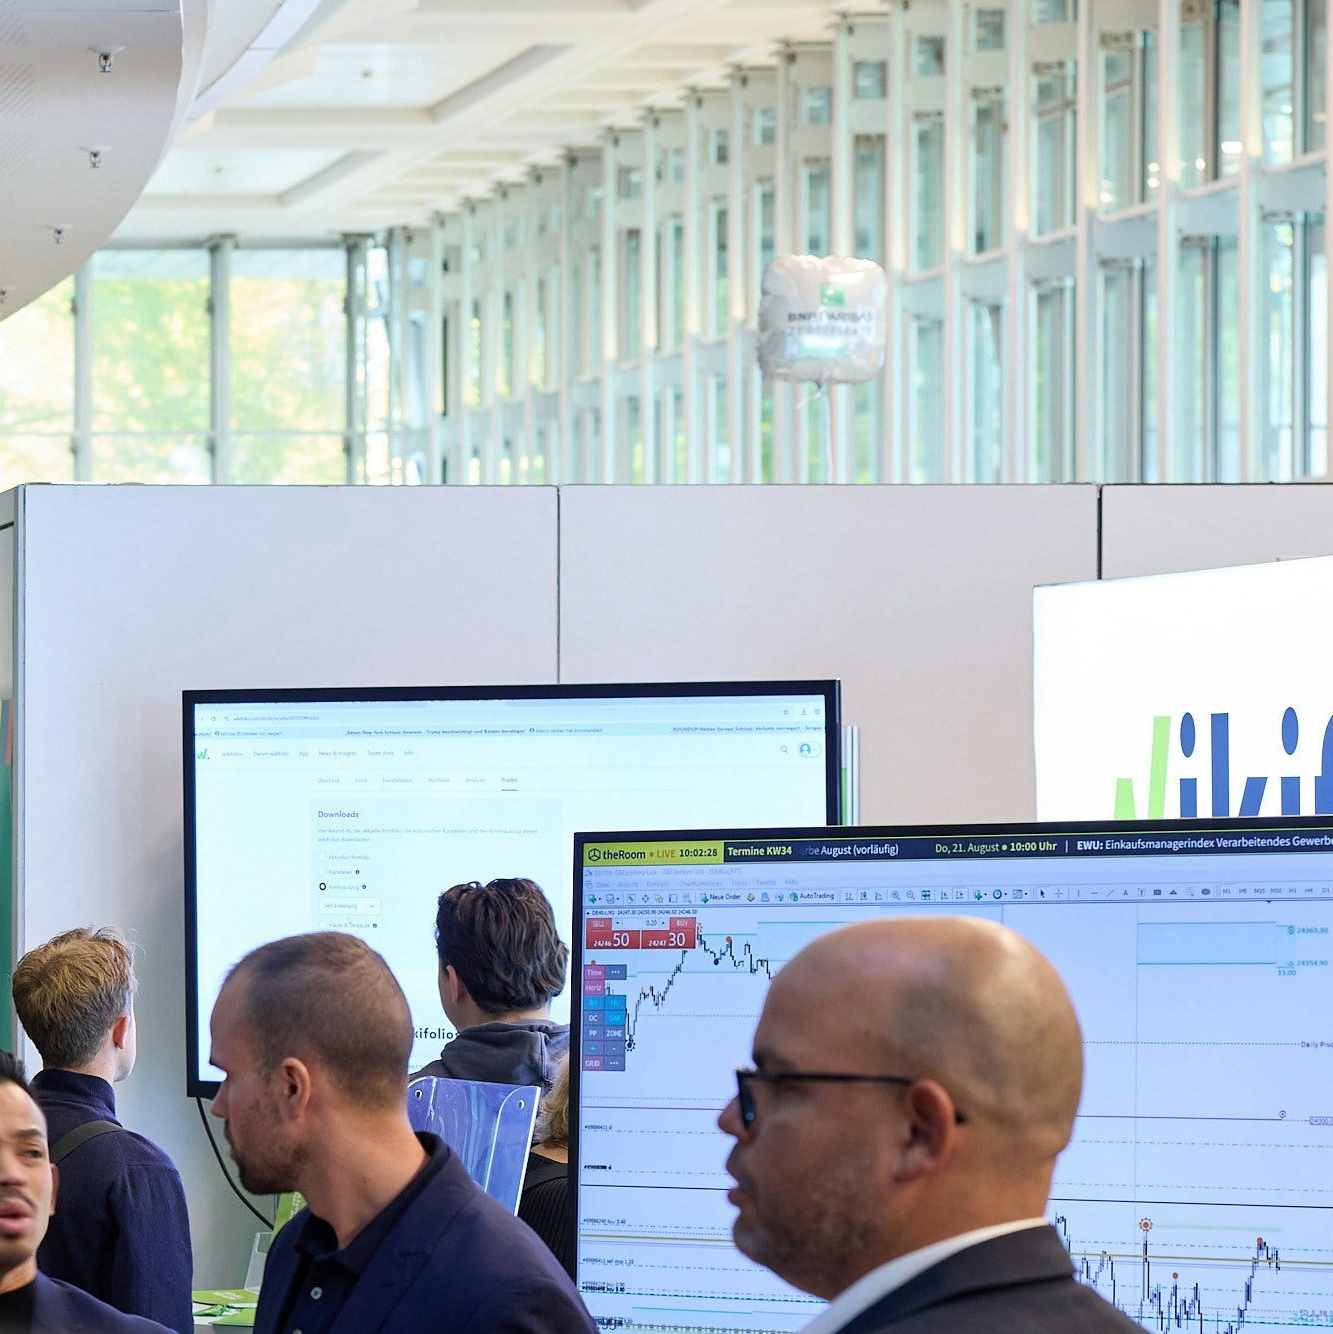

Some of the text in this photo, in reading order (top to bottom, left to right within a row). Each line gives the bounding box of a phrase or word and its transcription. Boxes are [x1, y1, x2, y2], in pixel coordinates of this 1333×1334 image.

[317, 810, 359, 818] Downloads
[936, 843, 951, 854] Do,
[953, 843, 966, 852] 21.
[967, 842, 999, 854] August
[1010, 842, 1035, 852] 10:00
[1038, 841, 1057, 851] Uhr
[1077, 840, 1103, 850] EWU:
[1105, 838, 1215, 852] Einkaufsmanagerindex
[1216, 836, 1291, 848] Verarbeitendes
[603, 850, 645, 860] theRoom
[657, 850, 675, 858] LIVE
[679, 848, 717, 858] 10:02:28
[728, 846, 793, 856] Termine KW34
[821, 846, 851, 859] August
[853, 844, 899, 857] (vorläufig)
[799, 892, 835, 901] AutoTrading
[613, 933, 630, 946] 50
[669, 932, 686, 946] 30
[589, 1014, 598, 1022] OC
[606, 1029, 623, 1037] ZONE
